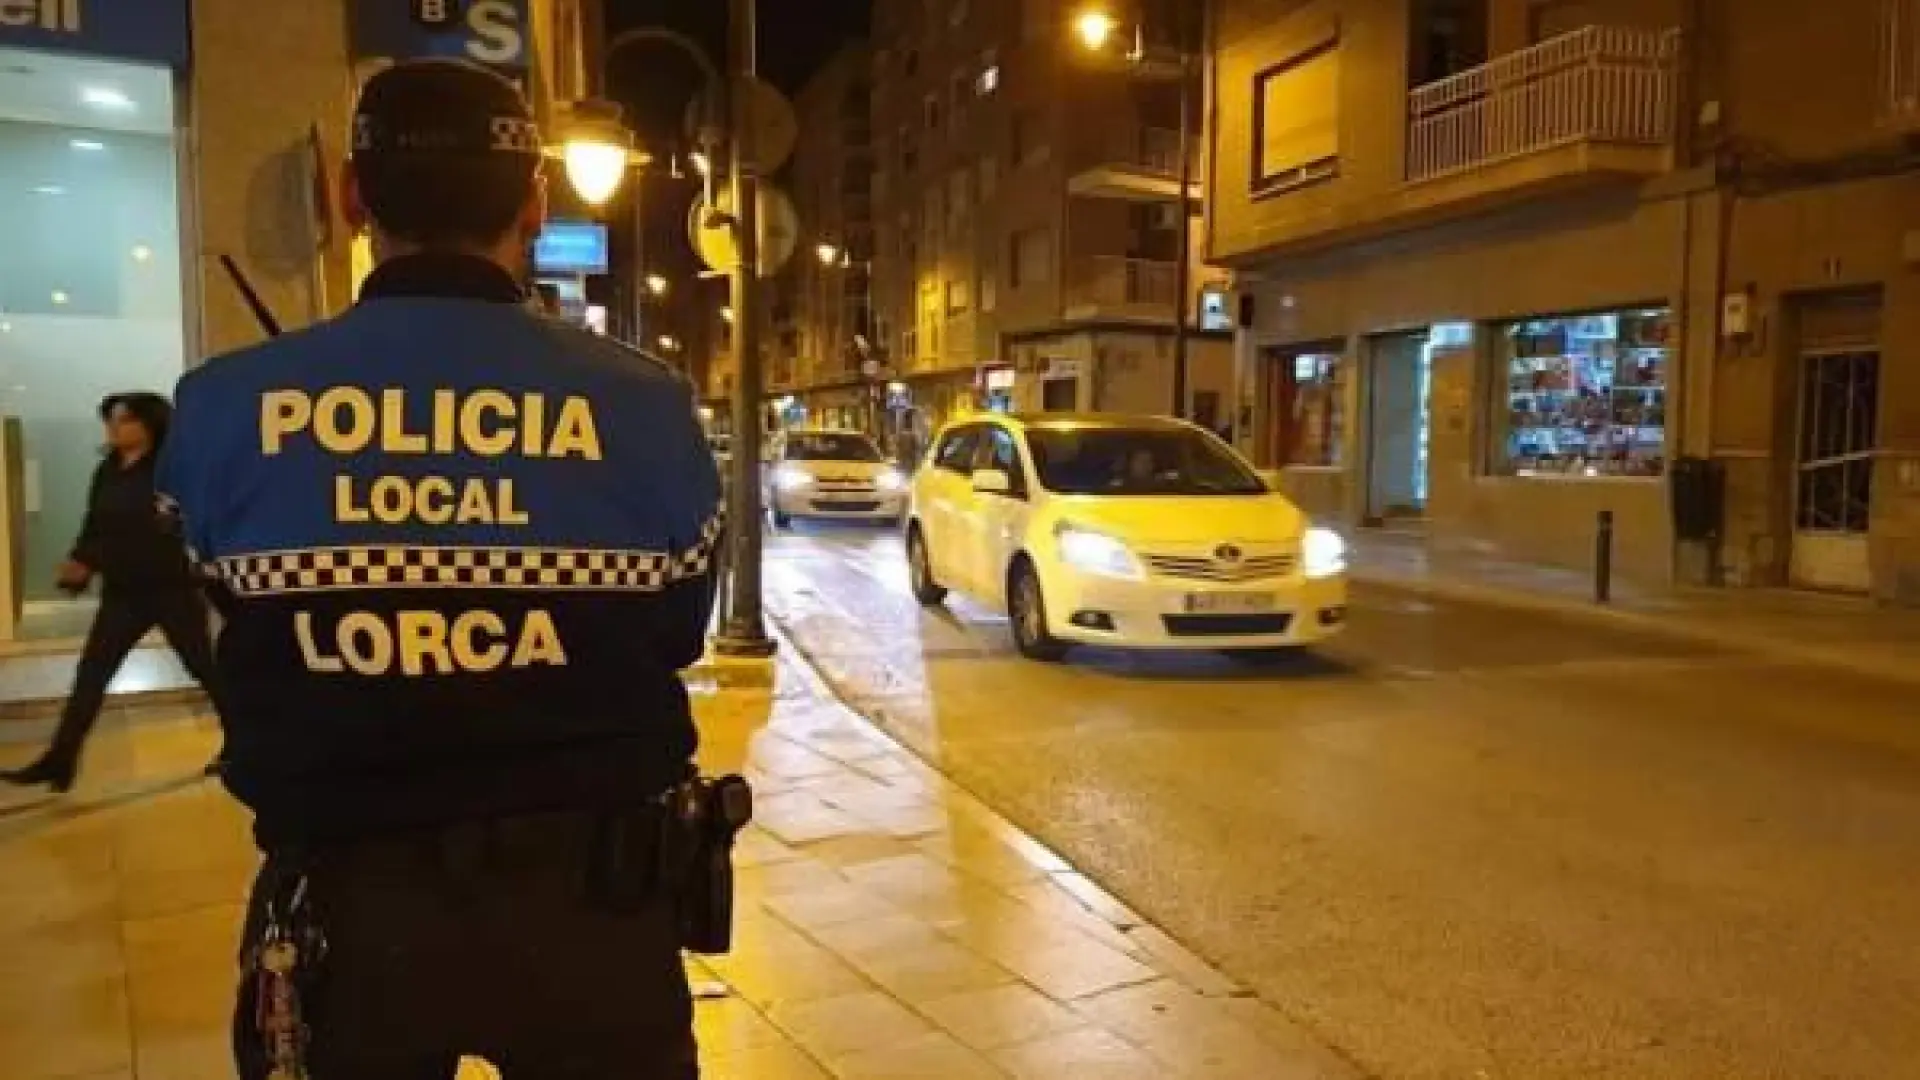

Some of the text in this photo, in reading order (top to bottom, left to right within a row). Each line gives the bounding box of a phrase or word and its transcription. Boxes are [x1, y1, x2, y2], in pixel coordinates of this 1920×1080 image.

[464, 2, 521, 62] S
[259, 385, 603, 461] POLICIA
[335, 475, 529, 525] LOCAL
[294, 609, 568, 676] LORCA
